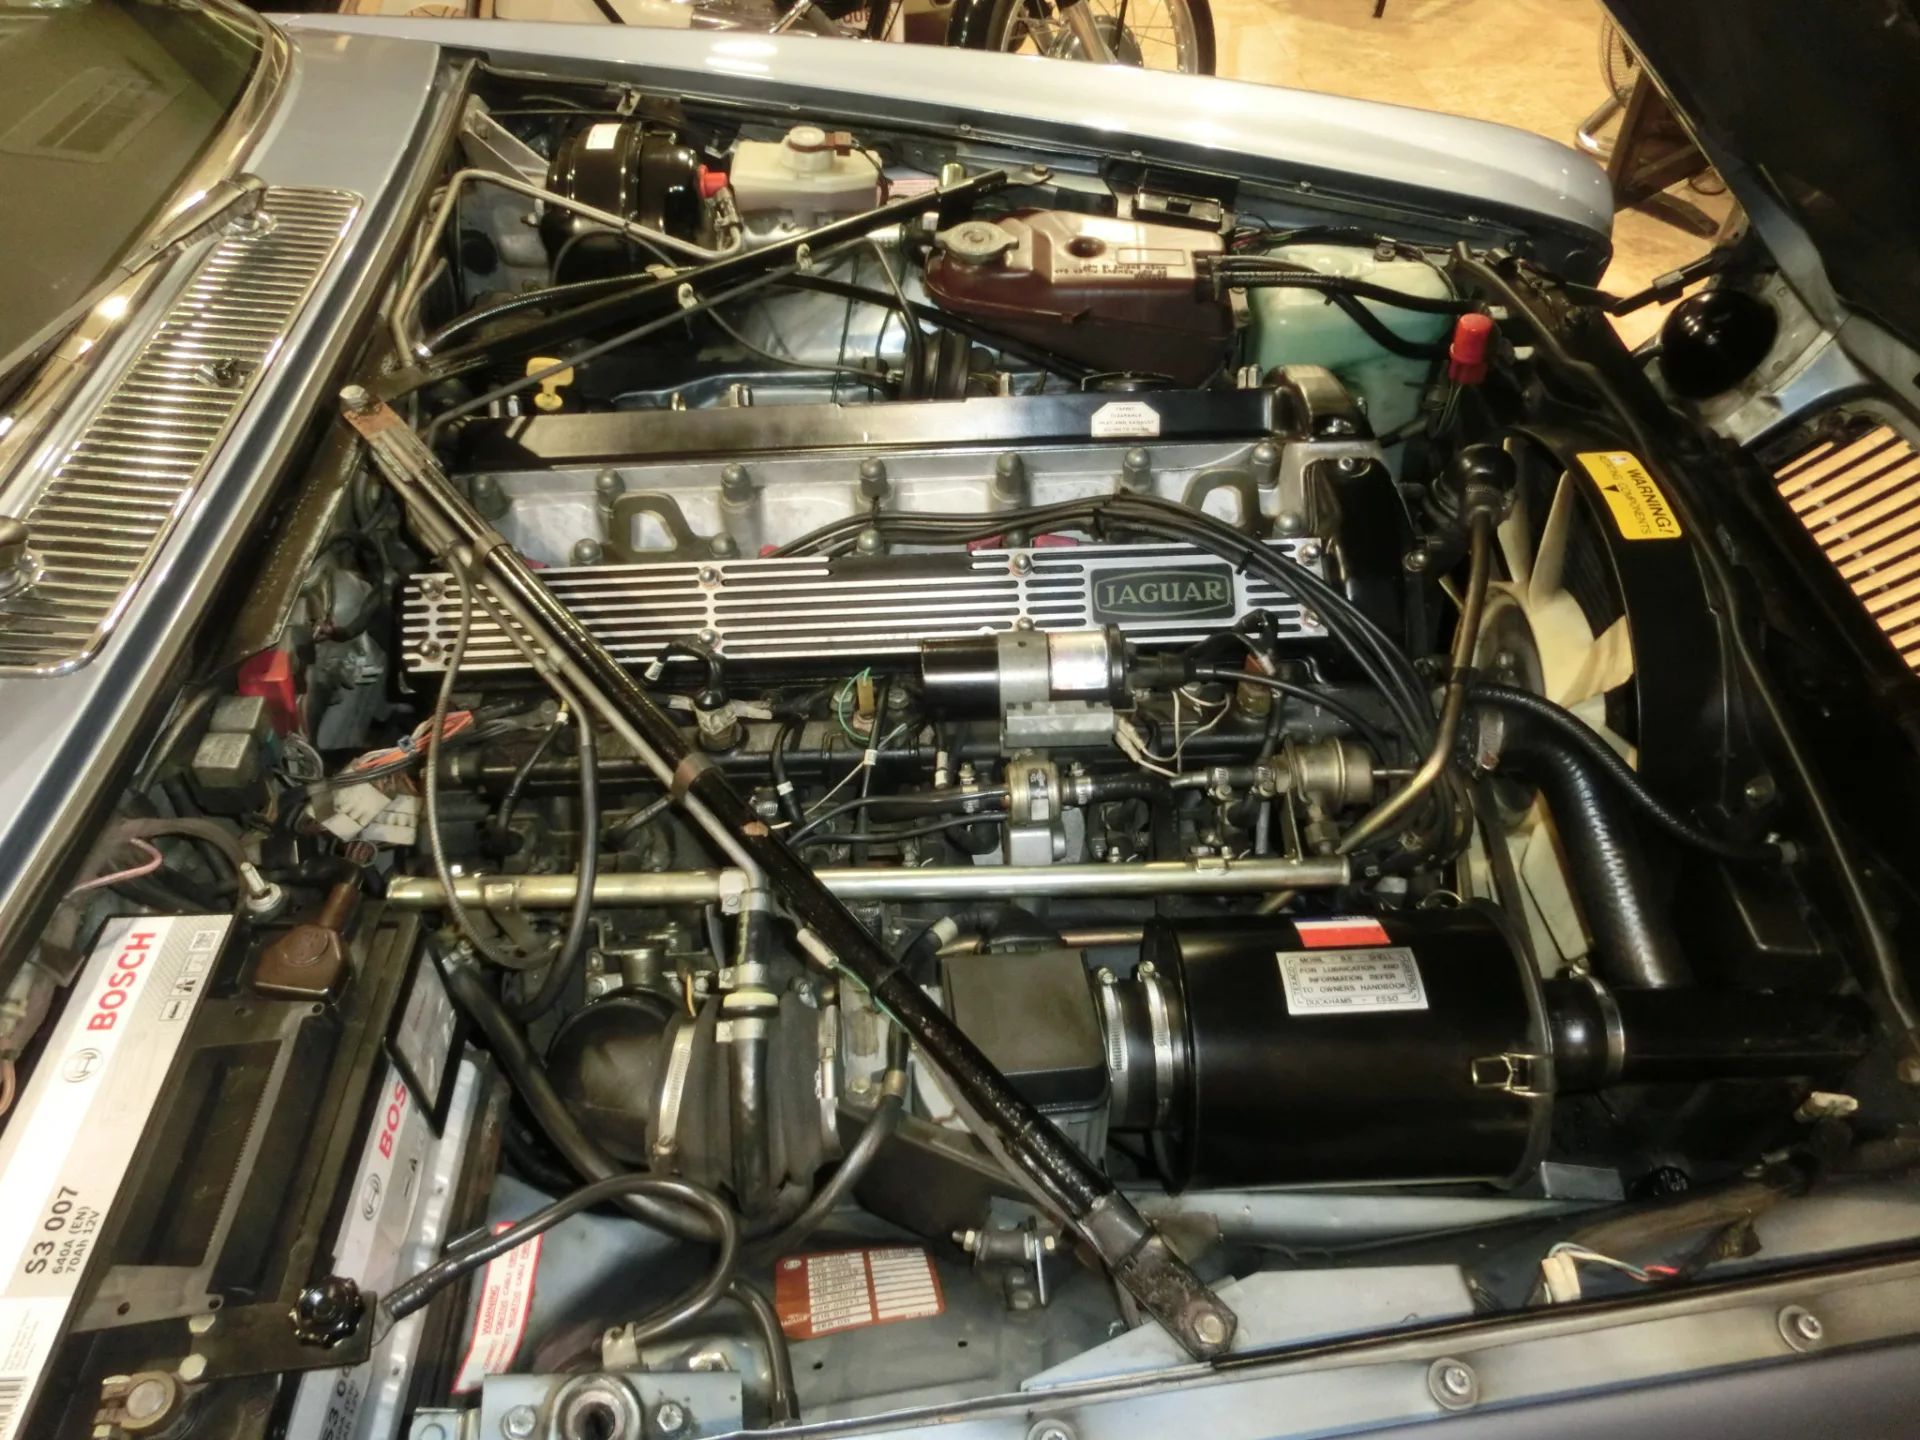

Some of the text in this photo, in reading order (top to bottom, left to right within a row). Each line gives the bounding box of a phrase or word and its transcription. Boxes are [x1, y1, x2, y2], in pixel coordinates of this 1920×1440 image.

[1626, 467, 1675, 534] WARNING!
[1101, 580, 1225, 607] JAGUAR
[86, 932, 157, 1031] BOSCH
[1360, 983, 1406, 991] HANDBOOK
[379, 1080, 407, 1160] BOS
[24, 1186, 78, 1274] S3 007
[52, 1239, 76, 1274] 640A
[65, 1210, 100, 1274] 70Ah 12V
[482, 1285, 501, 1336] WARNING
[336, 1365, 352, 1397] 00
